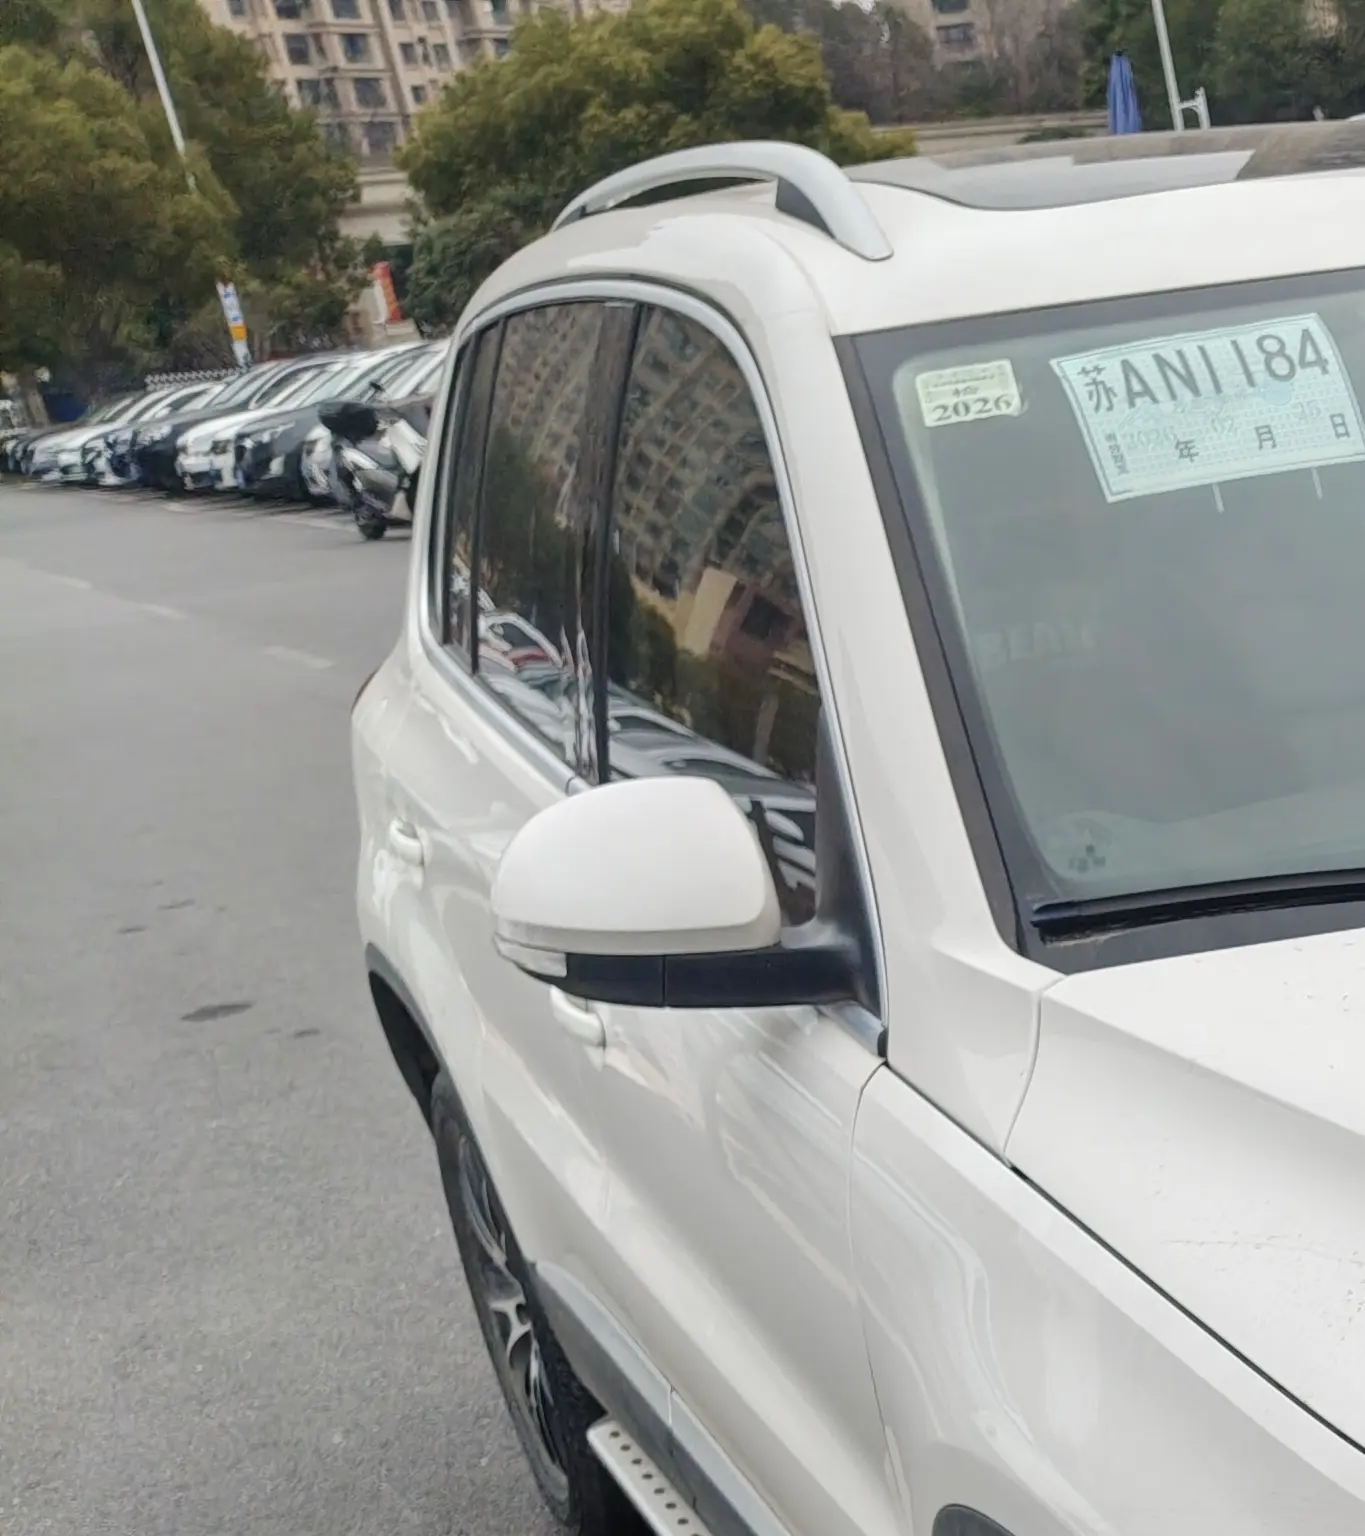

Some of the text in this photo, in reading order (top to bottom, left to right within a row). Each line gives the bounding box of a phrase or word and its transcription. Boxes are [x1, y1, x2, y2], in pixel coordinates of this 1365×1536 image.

[1077, 328, 1330, 413] 苏AN1184
[932, 392, 1015, 423] 2026
[1175, 439, 1199, 462] 年
[1255, 425, 1277, 450] 月
[1330, 413, 1350, 440] 日
